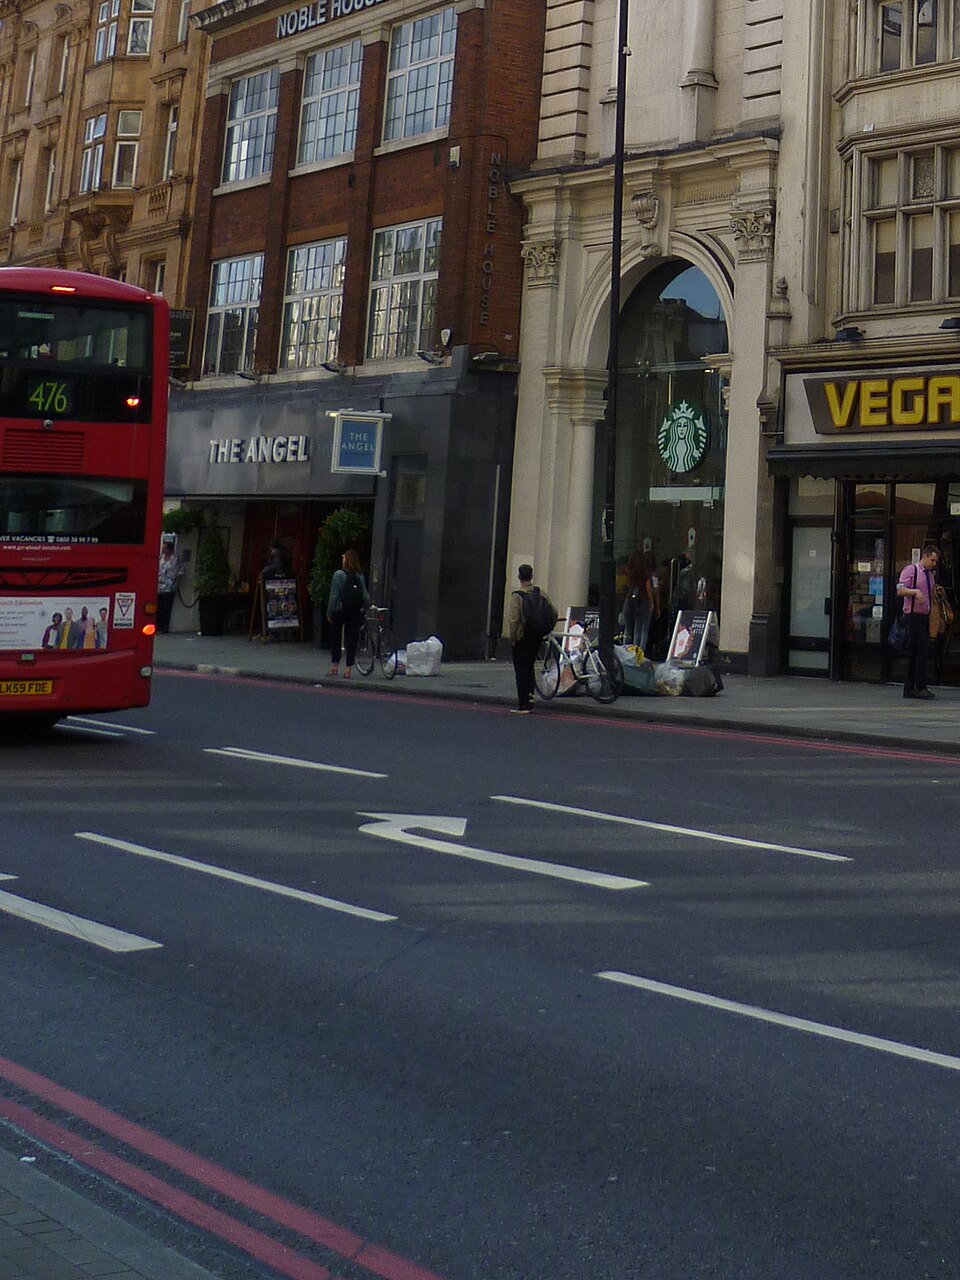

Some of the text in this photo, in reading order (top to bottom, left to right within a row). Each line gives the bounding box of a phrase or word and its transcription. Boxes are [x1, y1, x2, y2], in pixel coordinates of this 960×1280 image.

[276, 0, 327, 38] NOBLE
[480, 152, 501, 325] NOBLE HOUSE
[29, 381, 68, 412] 476
[349, 432, 369, 441] THE
[209, 435, 310, 464] THE ANGEL
[341, 442, 375, 452] ANGEL
[11, 535, 46, 543] VACANCIES
[0, 682, 48, 693] LK59 FDE
